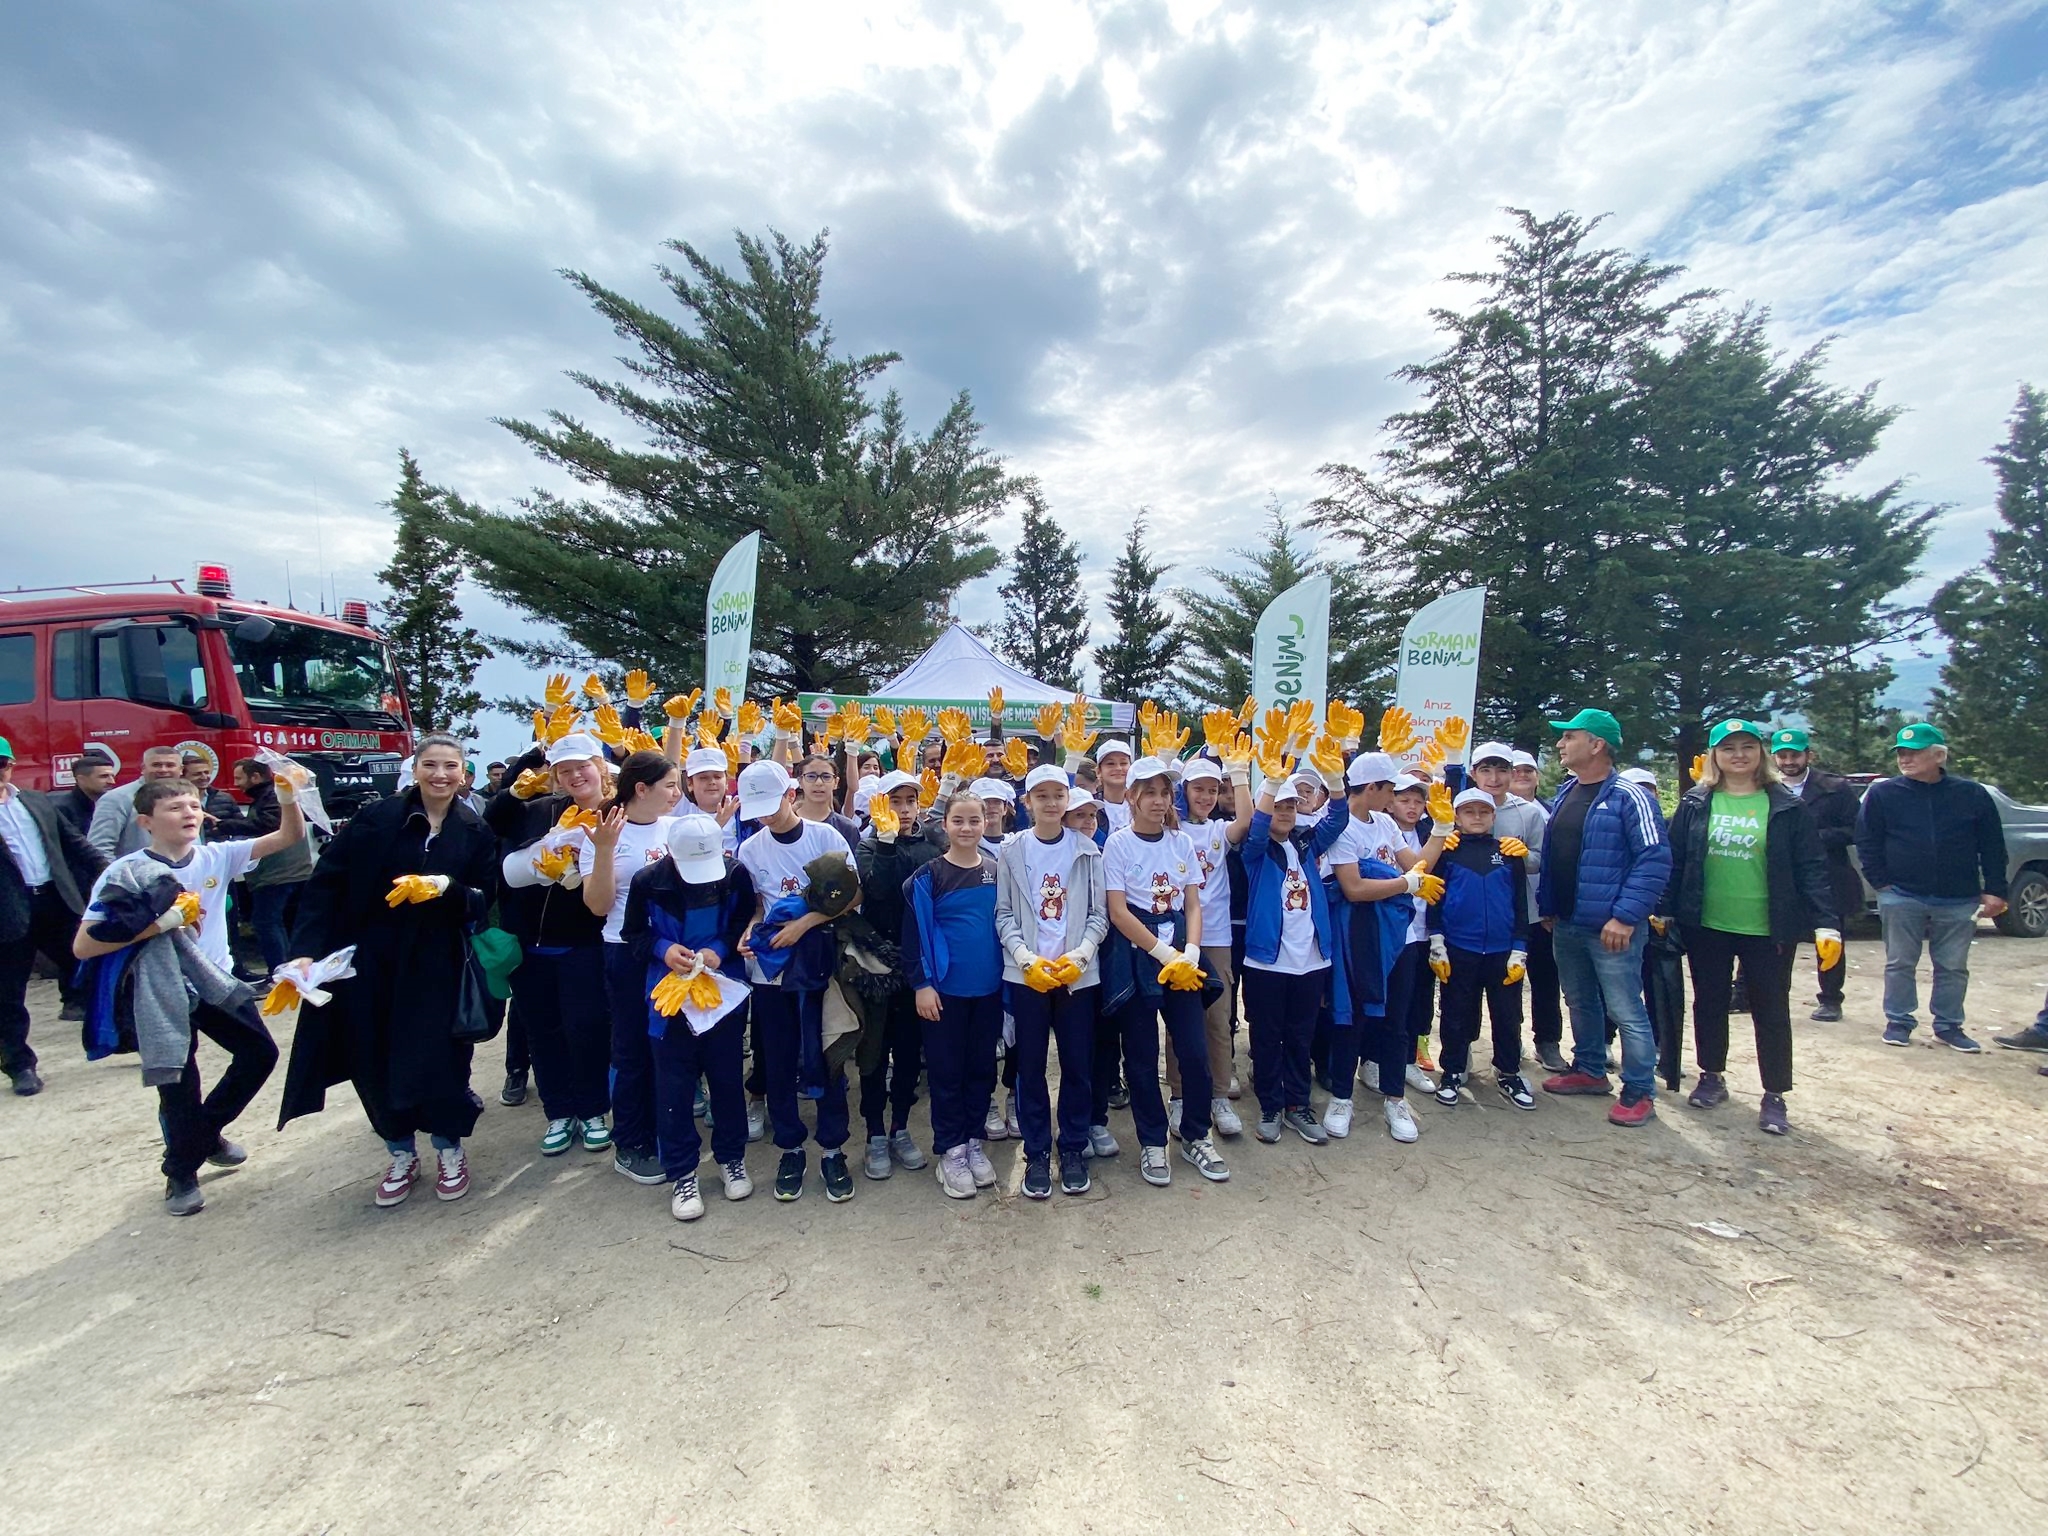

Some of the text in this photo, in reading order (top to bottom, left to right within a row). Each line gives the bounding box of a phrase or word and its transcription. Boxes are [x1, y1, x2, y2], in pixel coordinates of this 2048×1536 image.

[1408, 631, 1478, 651] ORMAN
[978, 701, 1013, 725] İŞLME
[253, 731, 381, 749] 16 A 114 ORMAN
[333, 776, 373, 786] MAN
[1711, 813, 1760, 829] TEMA
